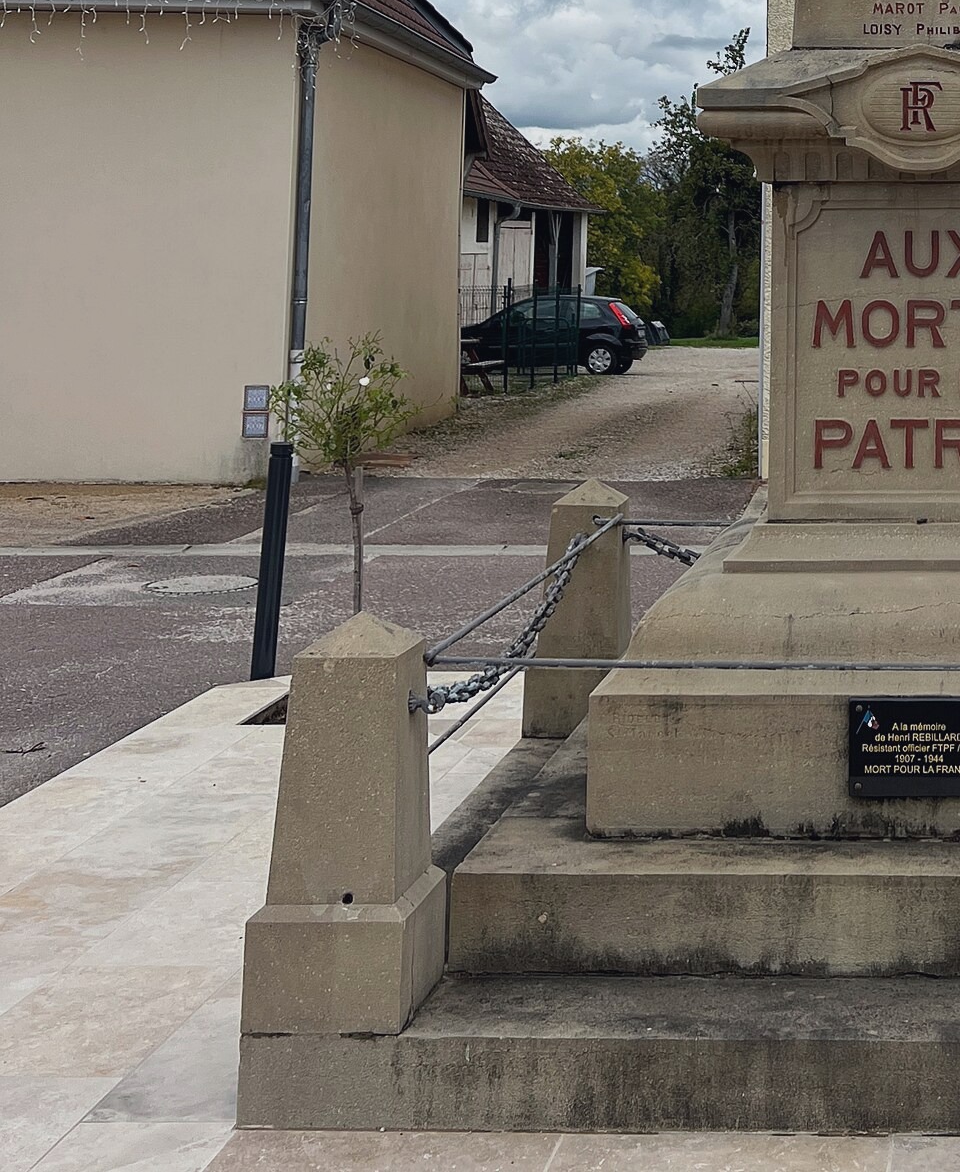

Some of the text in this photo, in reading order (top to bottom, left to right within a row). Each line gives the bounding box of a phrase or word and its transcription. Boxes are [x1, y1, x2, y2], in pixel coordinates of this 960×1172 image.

[873, 3, 925, 14] MAROT
[863, 24, 902, 35] LOISY
[837, 369, 940, 398] POUR
[900, 723, 908, 731] la
[910, 723, 946, 731] mémoire
[875, 733, 885, 741] de
[888, 733, 910, 741] Henri
[862, 744, 900, 752] Résistant
[903, 744, 930, 752] officier
[932, 744, 954, 752] FTPF
[895, 755, 915, 763] 1907
[924, 755, 943, 763] 1944
[865, 765, 891, 773] MORT
[894, 765, 920, 773] POUR
[923, 765, 934, 773] LA
